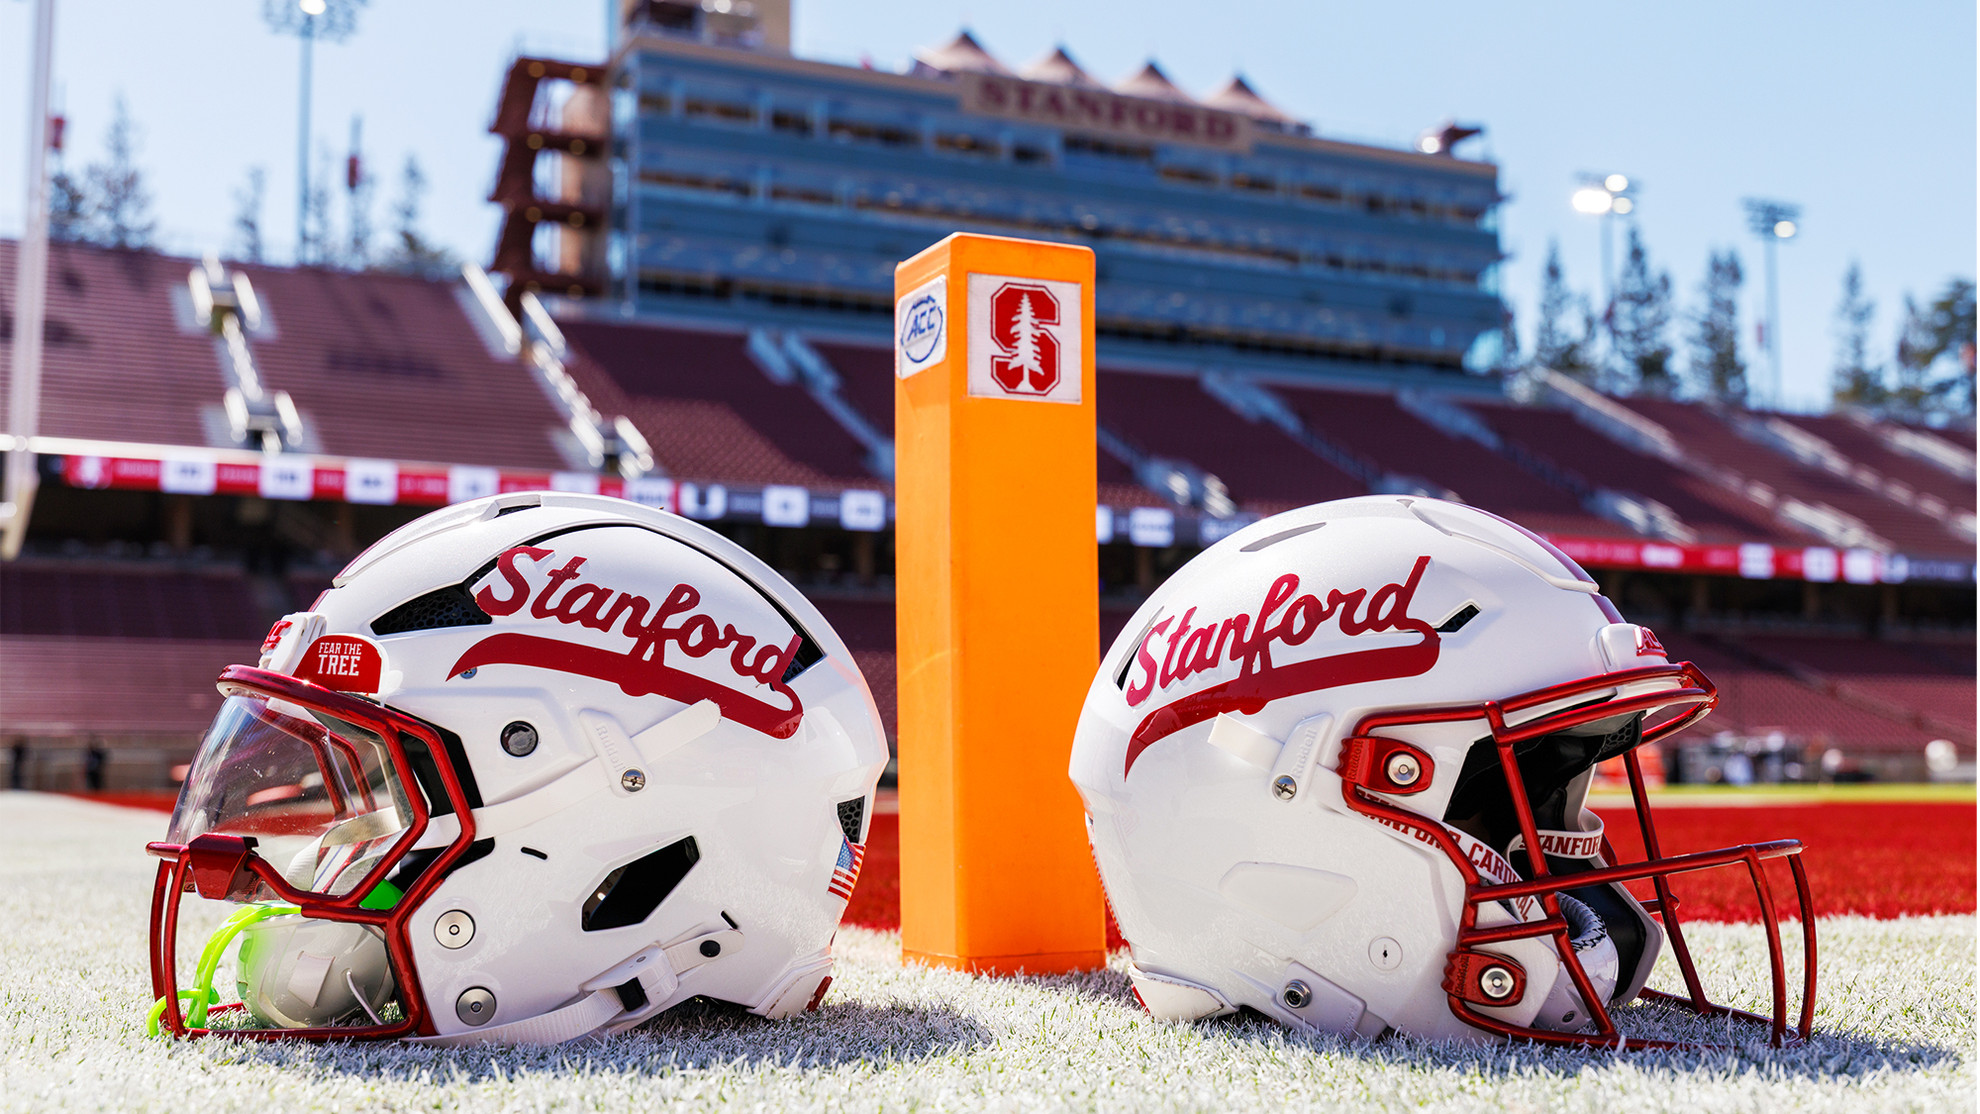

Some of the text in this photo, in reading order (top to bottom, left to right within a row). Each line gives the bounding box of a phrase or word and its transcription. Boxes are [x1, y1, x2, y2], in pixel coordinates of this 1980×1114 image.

[979, 79, 1237, 139] STANFORD
[907, 305, 937, 341] ACC
[474, 545, 803, 690] Stanford
[1126, 555, 1436, 708] Stanford
[317, 654, 362, 677] TREE
[318, 641, 363, 656] FEAR THE
